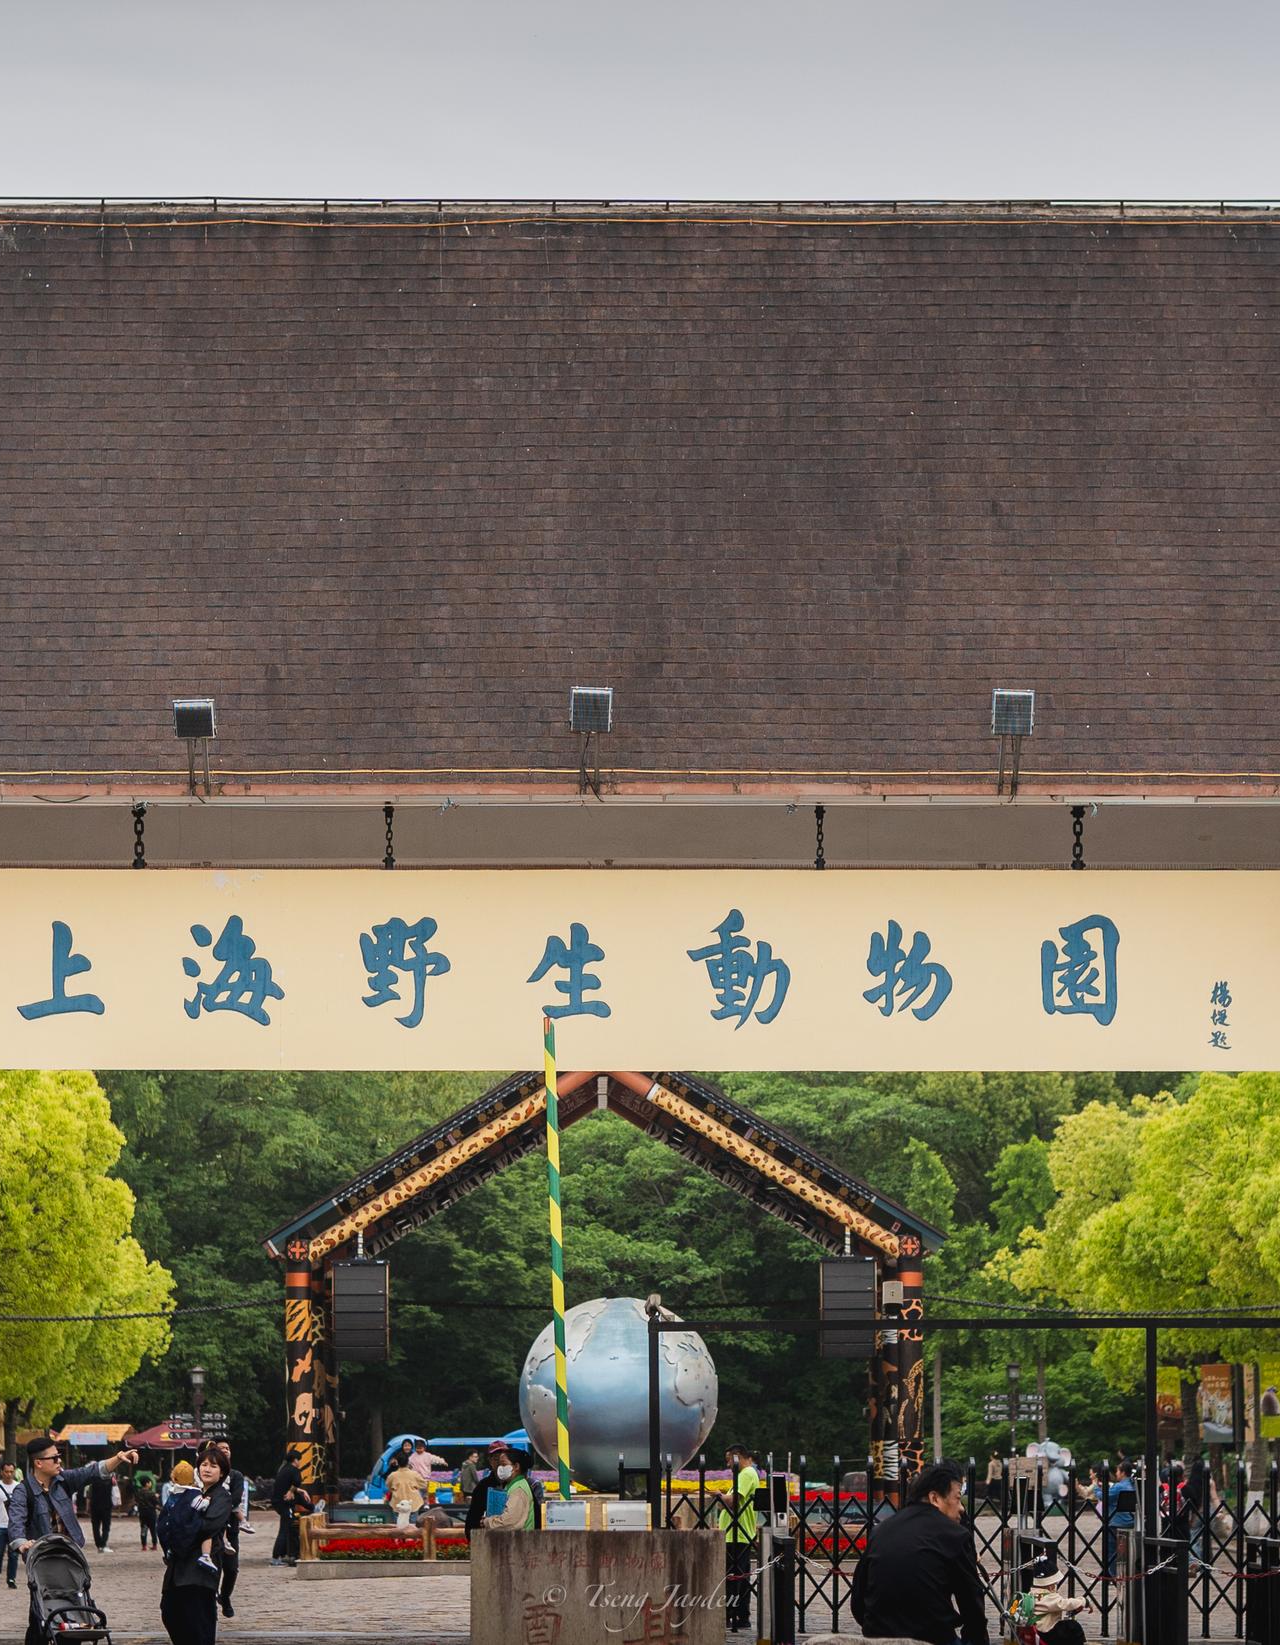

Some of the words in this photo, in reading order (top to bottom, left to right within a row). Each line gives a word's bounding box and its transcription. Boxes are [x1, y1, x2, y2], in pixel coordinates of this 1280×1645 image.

[16, 908, 1121, 1029] 上海野生動物園
